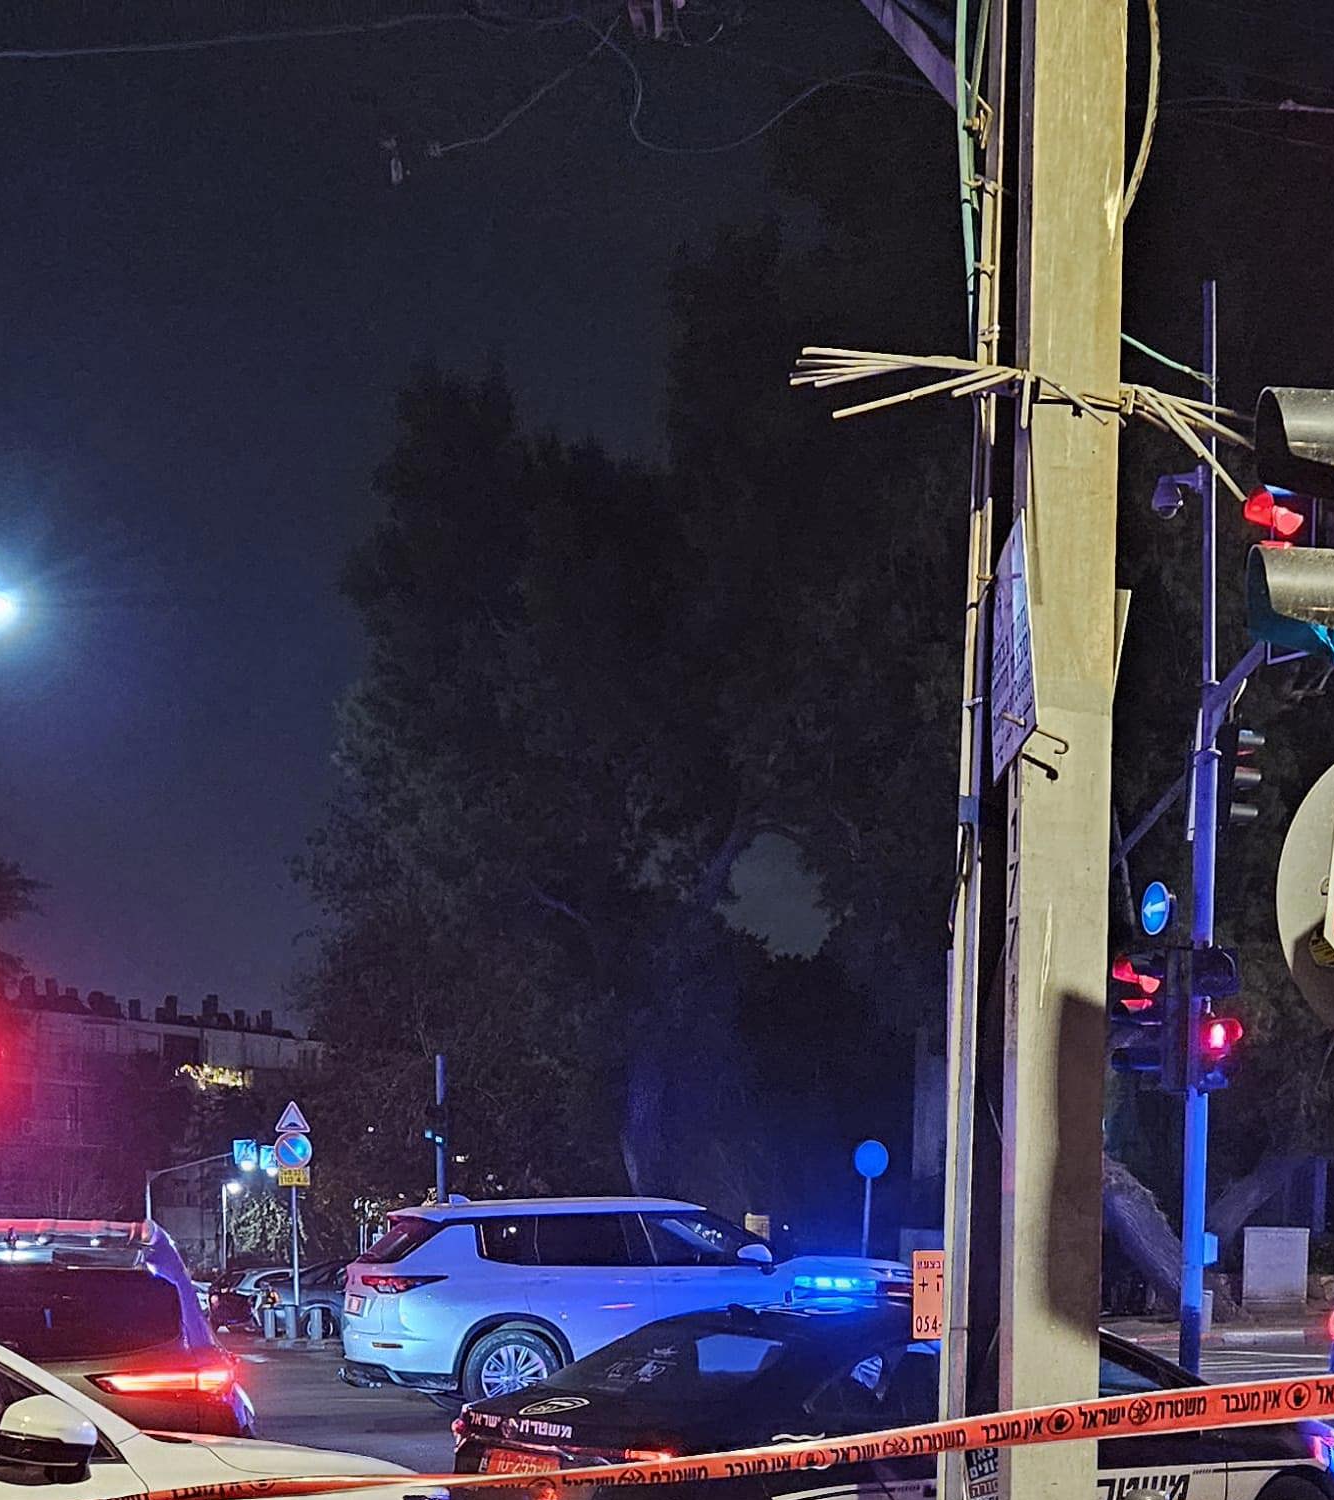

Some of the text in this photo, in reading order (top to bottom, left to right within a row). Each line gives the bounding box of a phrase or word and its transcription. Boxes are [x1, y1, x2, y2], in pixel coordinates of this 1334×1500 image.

[916, 1315, 942, 1333] 054-
[1221, 1391, 1260, 1413] מעבר
[1260, 1389, 1281, 1414] אין
[469, 1411, 573, 1439] משטרת ישראל
[981, 1395, 1207, 1443] משטרת ישראל אין מעבר
[830, 1442, 879, 1464] ישראל
[912, 1429, 967, 1454] משטרת
[649, 1464, 709, 1485] משטרת
